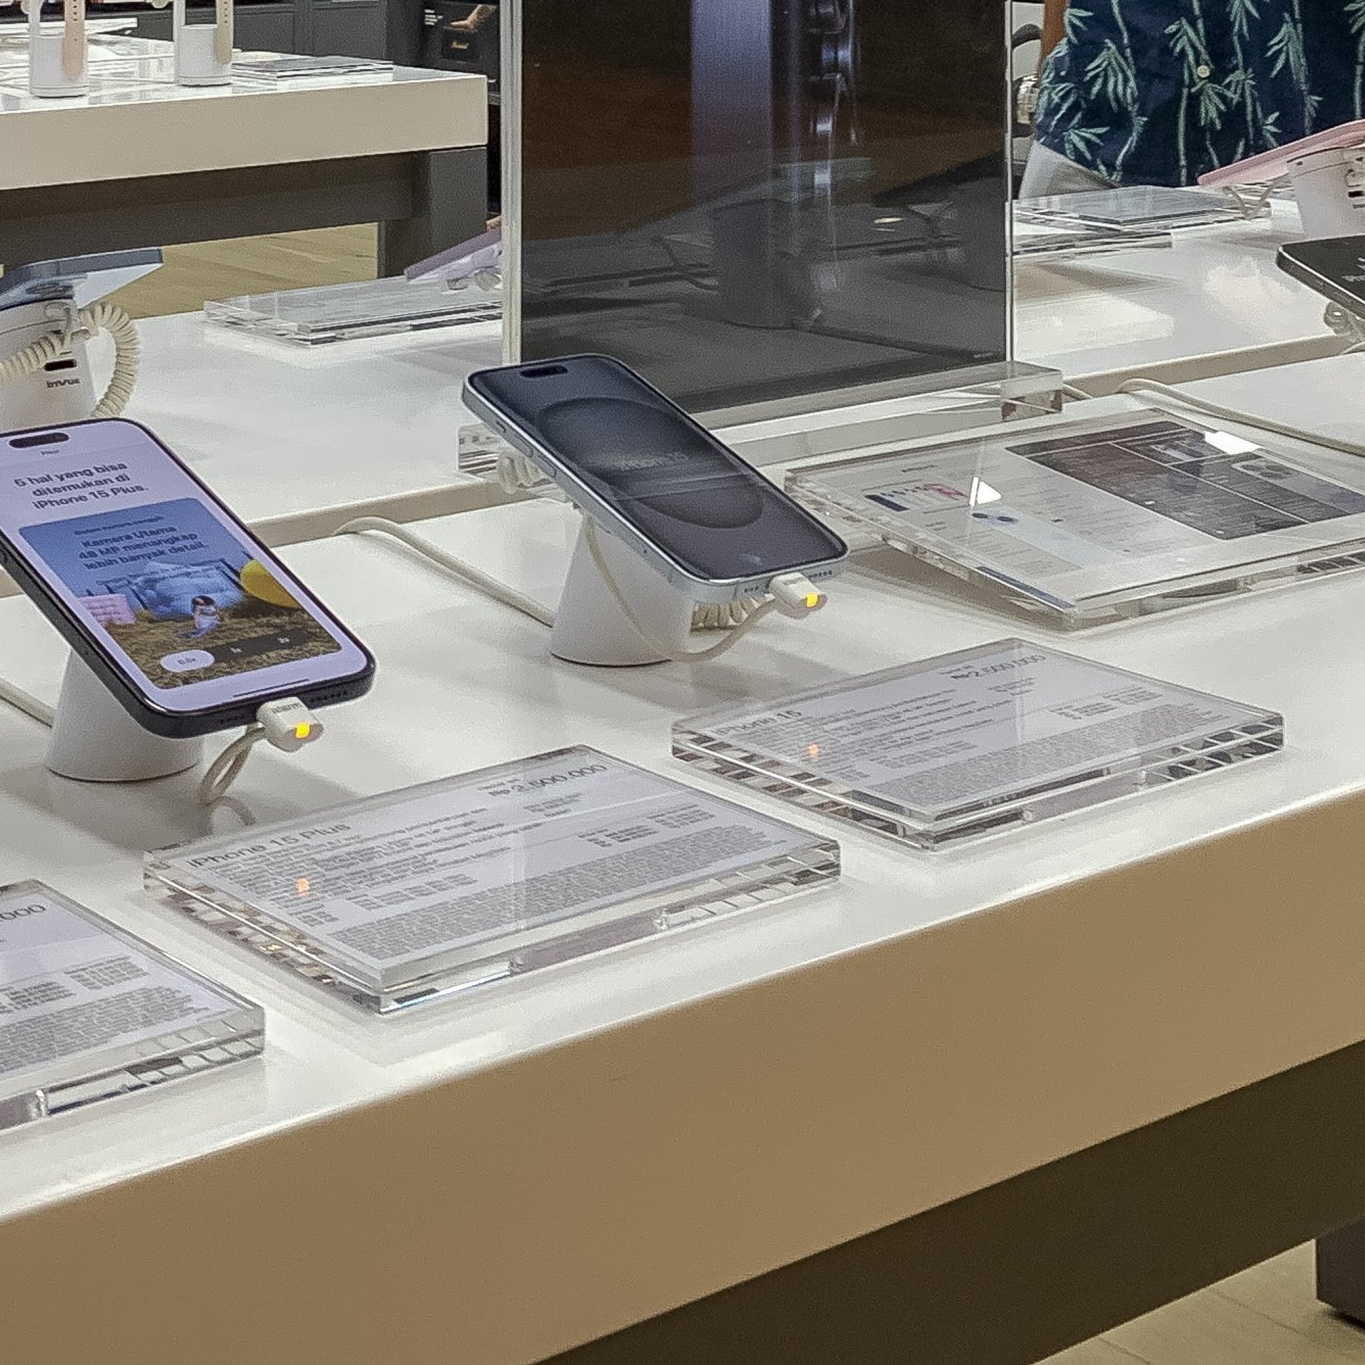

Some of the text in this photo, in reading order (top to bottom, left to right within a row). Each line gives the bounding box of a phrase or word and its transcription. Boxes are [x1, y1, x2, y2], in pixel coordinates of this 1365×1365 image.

[54, 467, 94, 482] yang
[93, 462, 128, 473] bisa
[32, 473, 131, 497] ditemukan di
[32, 495, 88, 510] iPhone
[89, 490, 110, 499] 15
[186, 844, 267, 868] iPhone
[299, 823, 351, 840] Plus
